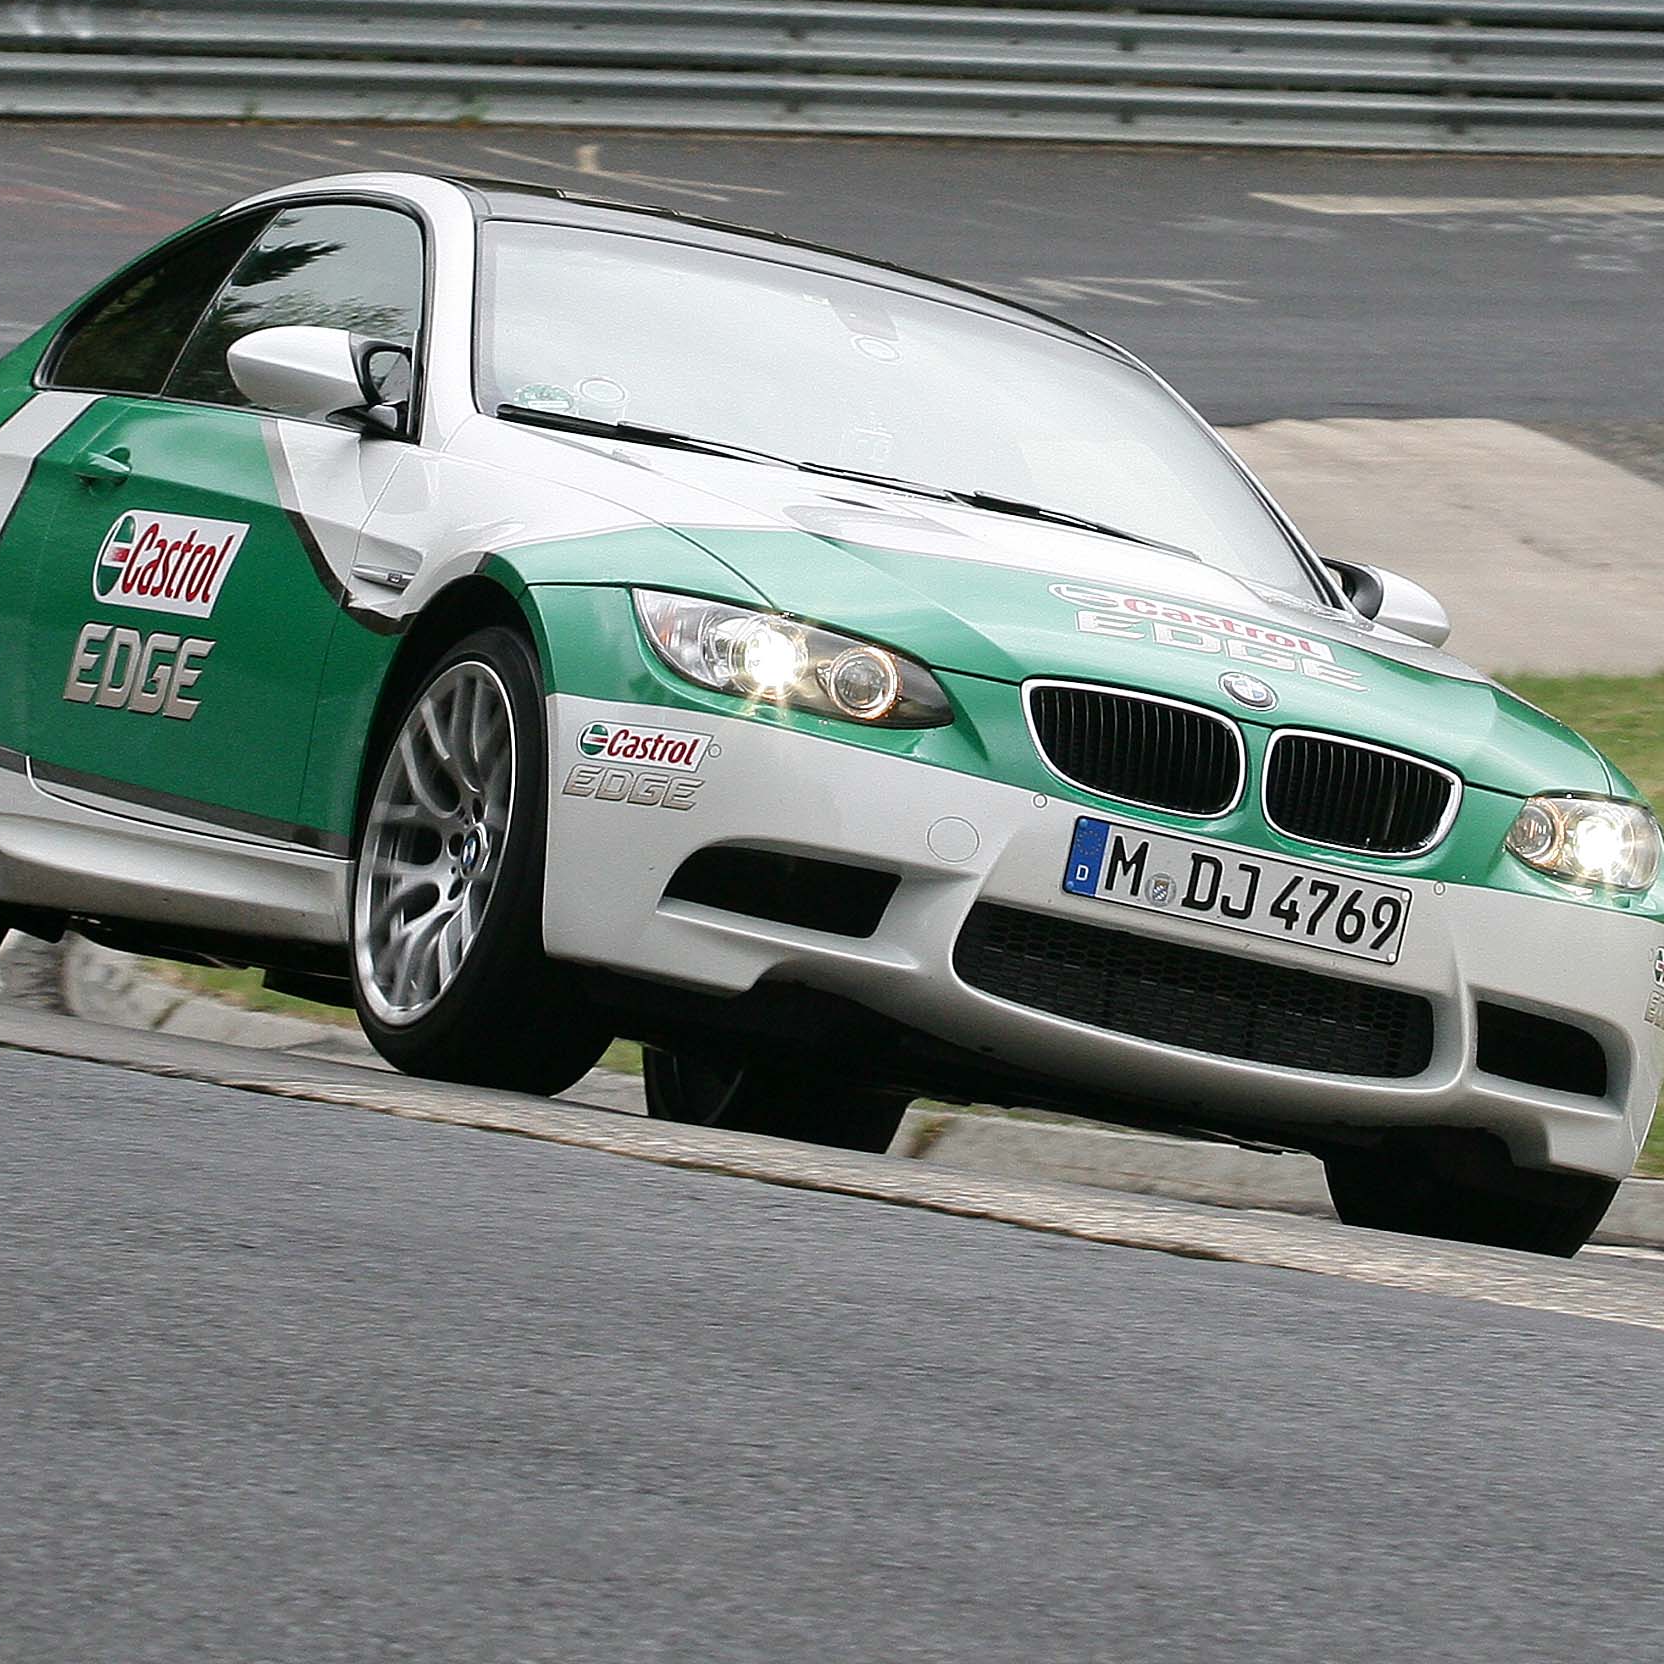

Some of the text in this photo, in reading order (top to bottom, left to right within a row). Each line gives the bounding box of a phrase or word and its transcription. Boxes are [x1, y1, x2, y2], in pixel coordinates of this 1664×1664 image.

[121, 523, 235, 604] Castrol
[1075, 609, 1369, 692] EDGE
[1123, 598, 1319, 656] Castrol
[63, 622, 216, 720] EDGE
[607, 729, 700, 766] Castrol
[562, 763, 706, 811] EDGE
[1075, 864, 1090, 882] D
[1104, 835, 1402, 950] M DJ 4769
